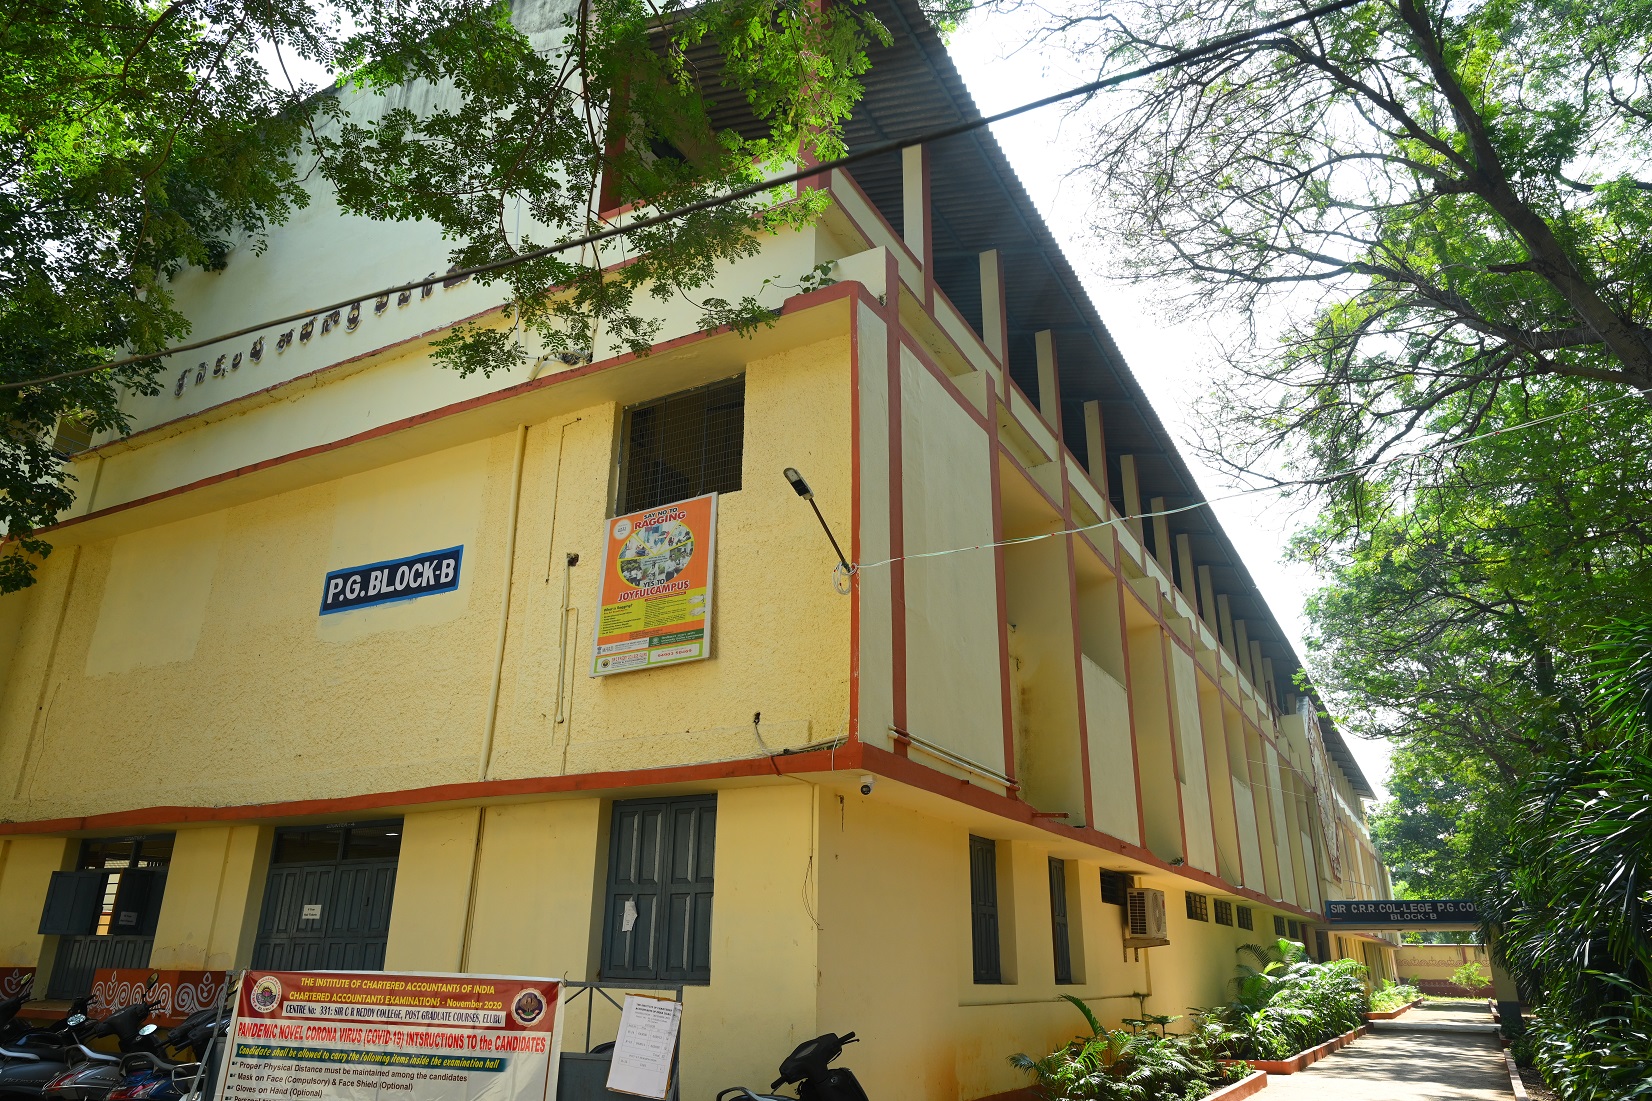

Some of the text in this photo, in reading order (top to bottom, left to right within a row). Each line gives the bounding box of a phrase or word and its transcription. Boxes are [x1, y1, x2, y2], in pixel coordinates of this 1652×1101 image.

[634, 511, 686, 530] RAGGING
[618, 580, 690, 602] JOYFULCAMPUS
[643, 579, 655, 588] YES
[1330, 904, 1346, 913] SIR
[301, 978, 495, 994] THE INSTITUTE OF CHARTERED ACCOUNTANTS OF INDIA
[289, 991, 330, 1001] CHARTERED
[331, 993, 384, 1004] ACCOUNTANTS
[385, 995, 440, 1006] EXAMINATIONS
[447, 998, 482, 1008] November
[484, 1001, 502, 1009] 2020
[285, 1004, 306, 1014] CENTRE
[308, 1005, 316, 1015] No:
[320, 1005, 332, 1016] 331:
[334, 1007, 343, 1016] SIR
[344, 1007, 349, 1016] C
[351, 1007, 355, 1016] R
[356, 1008, 375, 1018] REDDY
[376, 1008, 403, 1020] COLLEGE,
[404, 1010, 420, 1020] POST
[421, 1011, 452, 1021] GRADUATE
[453, 1012, 480, 1024] COURSES,
[238, 1022, 546, 1052] PANDEMIC NOVEL CORONA VIRUS (COVID-19) INTSRUCTIONS TO the CANDIDATES
[239, 1045, 500, 1069] Candidate shall be allowed to carry the following items inside the examination hall
[239, 1062, 261, 1070] Proper
[263, 1062, 293, 1072] Physical
[294, 1065, 322, 1073] Distance
[343, 1067, 351, 1075] be
[352, 1069, 390, 1077] maintained
[391, 1072, 414, 1080] among
[416, 1072, 427, 1080] the
[429, 1073, 467, 1082] candidates
[236, 1085, 257, 1093] Gloves
[270, 1087, 288, 1095] Hand
[290, 1088, 322, 1098] (Optional)
[266, 1075, 283, 1083] Face
[284, 1076, 330, 1086] (Compulsory)
[331, 1078, 336, 1086] &
[339, 1079, 354, 1087] Face
[356, 1080, 377, 1088] Shield
[380, 1081, 413, 1092] (Optional)
